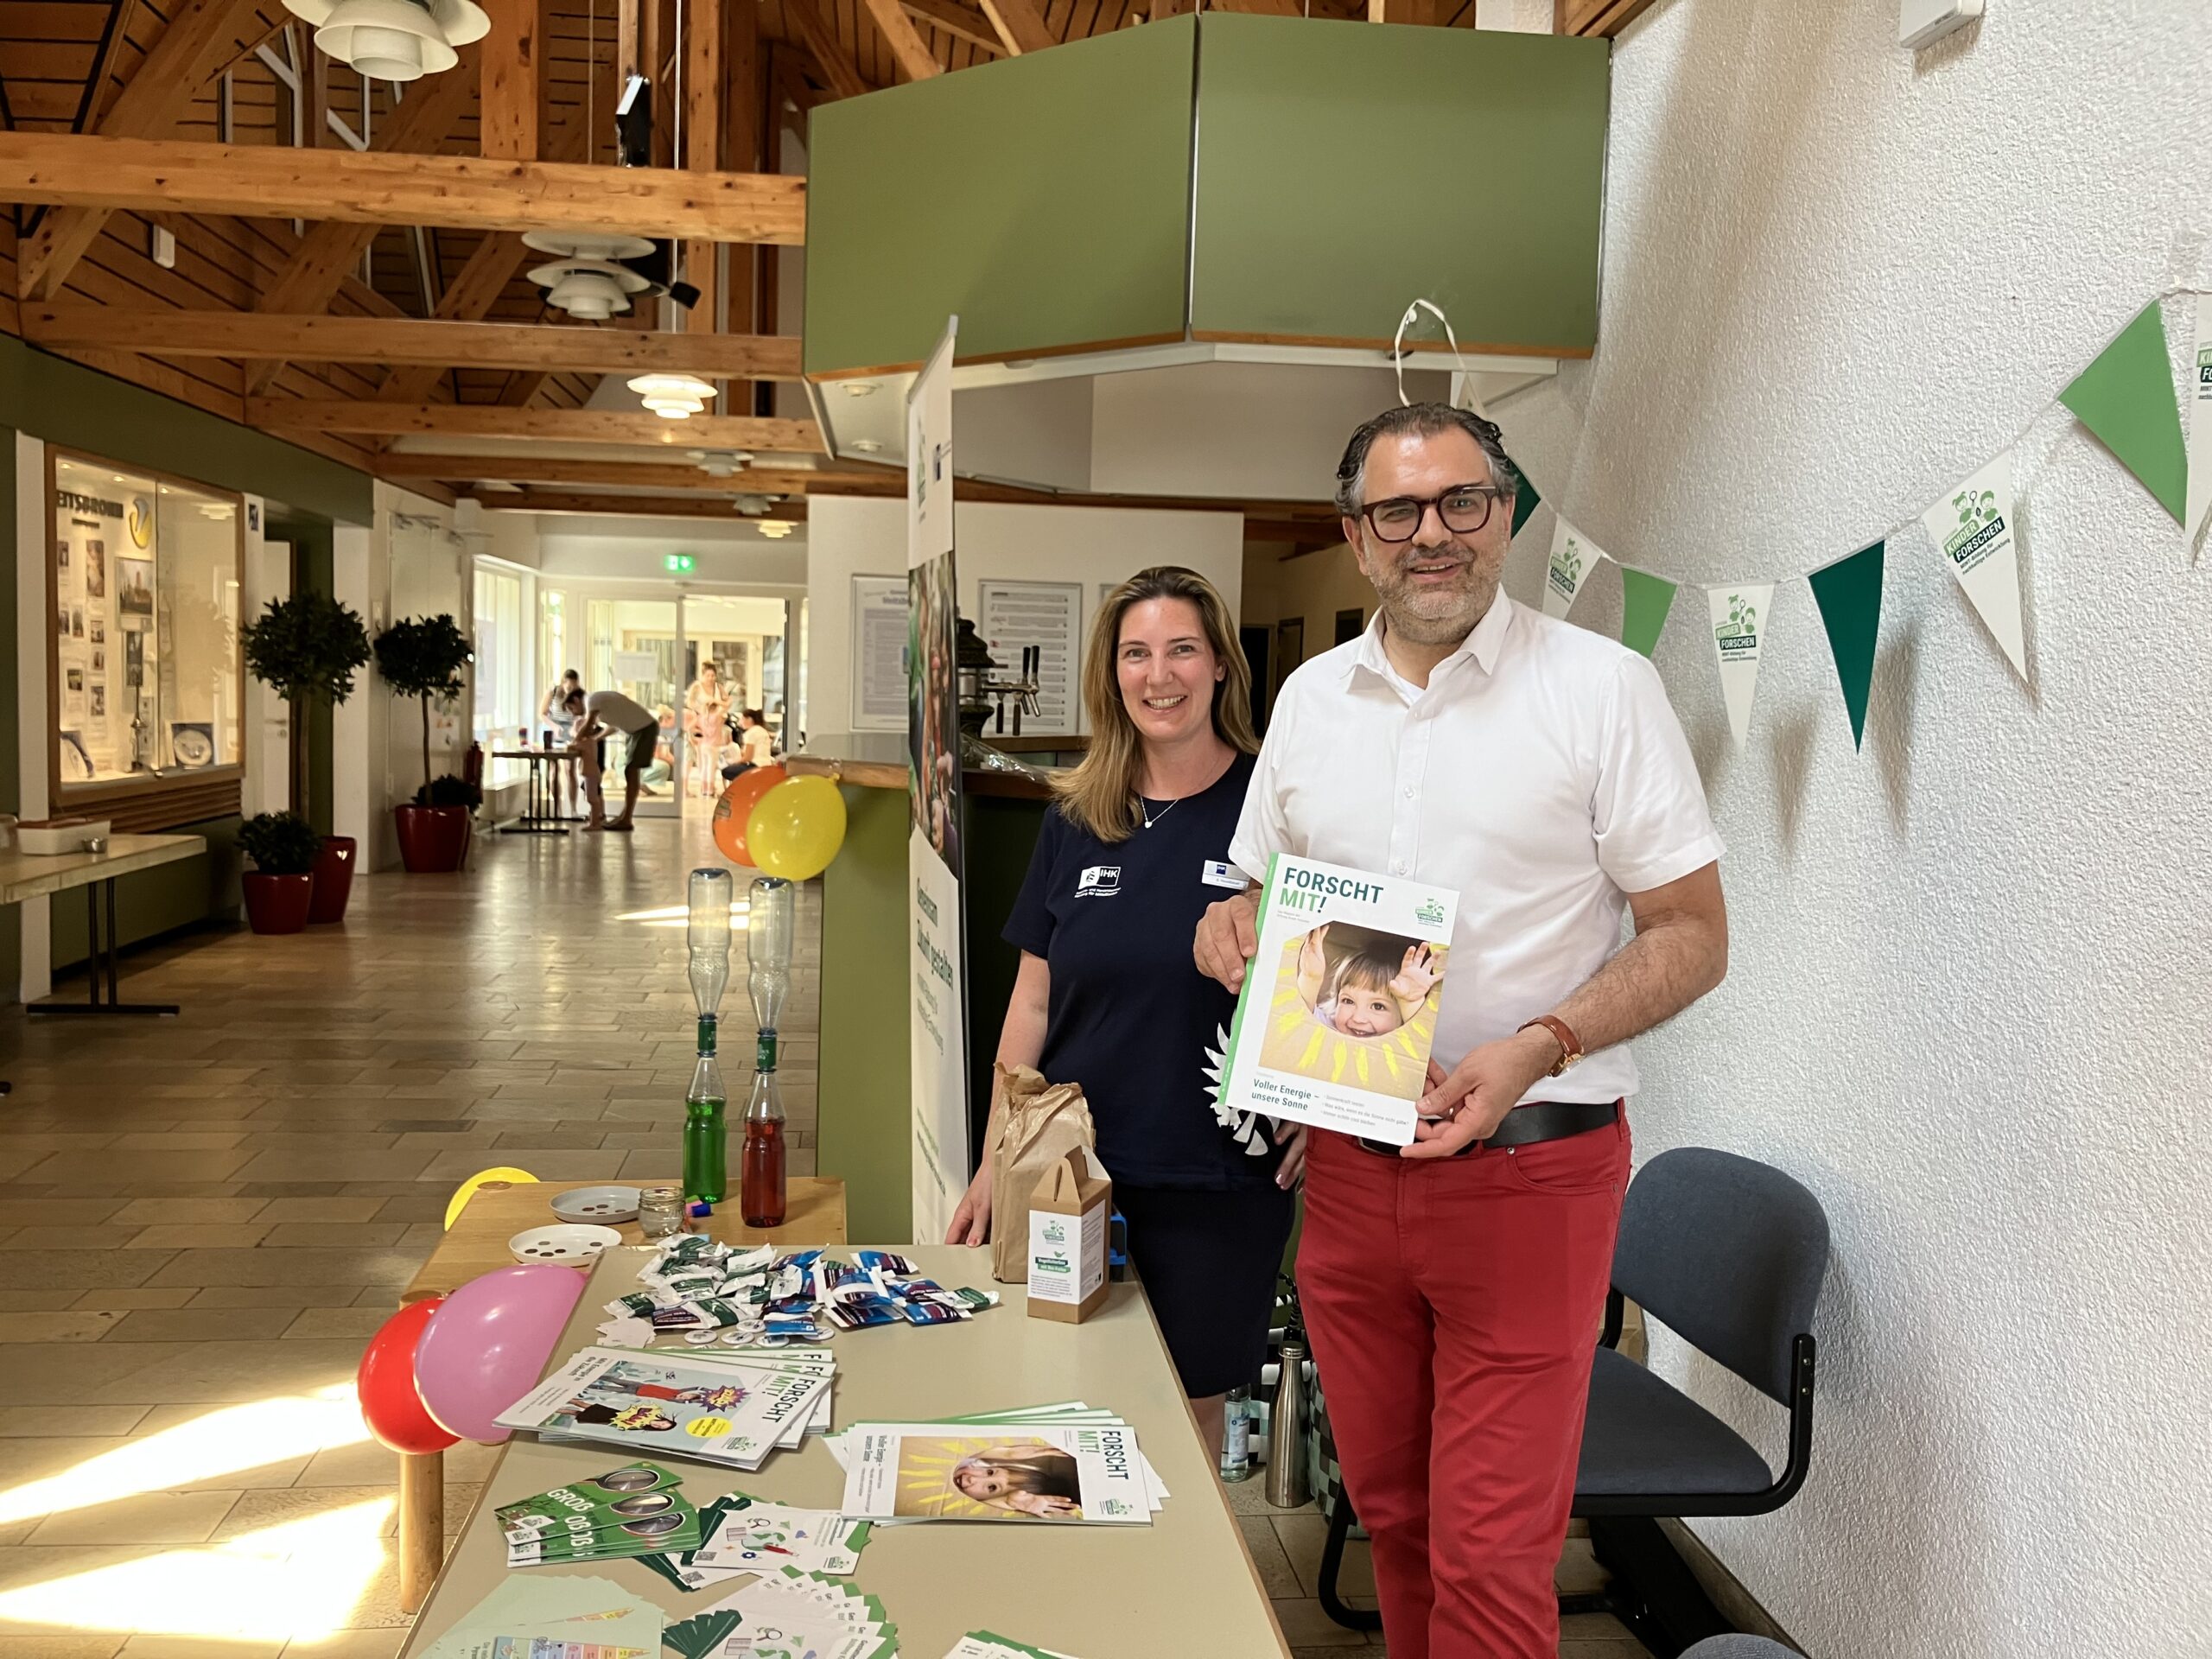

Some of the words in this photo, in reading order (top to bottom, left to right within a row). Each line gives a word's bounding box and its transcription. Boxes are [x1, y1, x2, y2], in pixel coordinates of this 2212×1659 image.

[1946, 521, 1977, 555] KINDER
[1955, 519, 2002, 562] FORSCHEN
[1551, 567, 1574, 593] FORSCHEN
[1717, 625, 1739, 638] KINDER
[1721, 637, 1755, 649] FORSCHEN
[1100, 868, 1118, 878] IHK
[1283, 867, 1384, 904] FORSCHT
[1279, 887, 1327, 913] MIT!
[1251, 1091, 1280, 1104] unsere
[1282, 1097, 1308, 1110] Sonne
[1254, 1078, 1278, 1091] Voller
[1280, 1084, 1312, 1099] Energie
[761, 1375, 795, 1397] MIT!
[761, 1377, 816, 1423] FORSCHT
[1077, 1430, 1100, 1453] MIT!
[1101, 1430, 1129, 1480] FORSCHT
